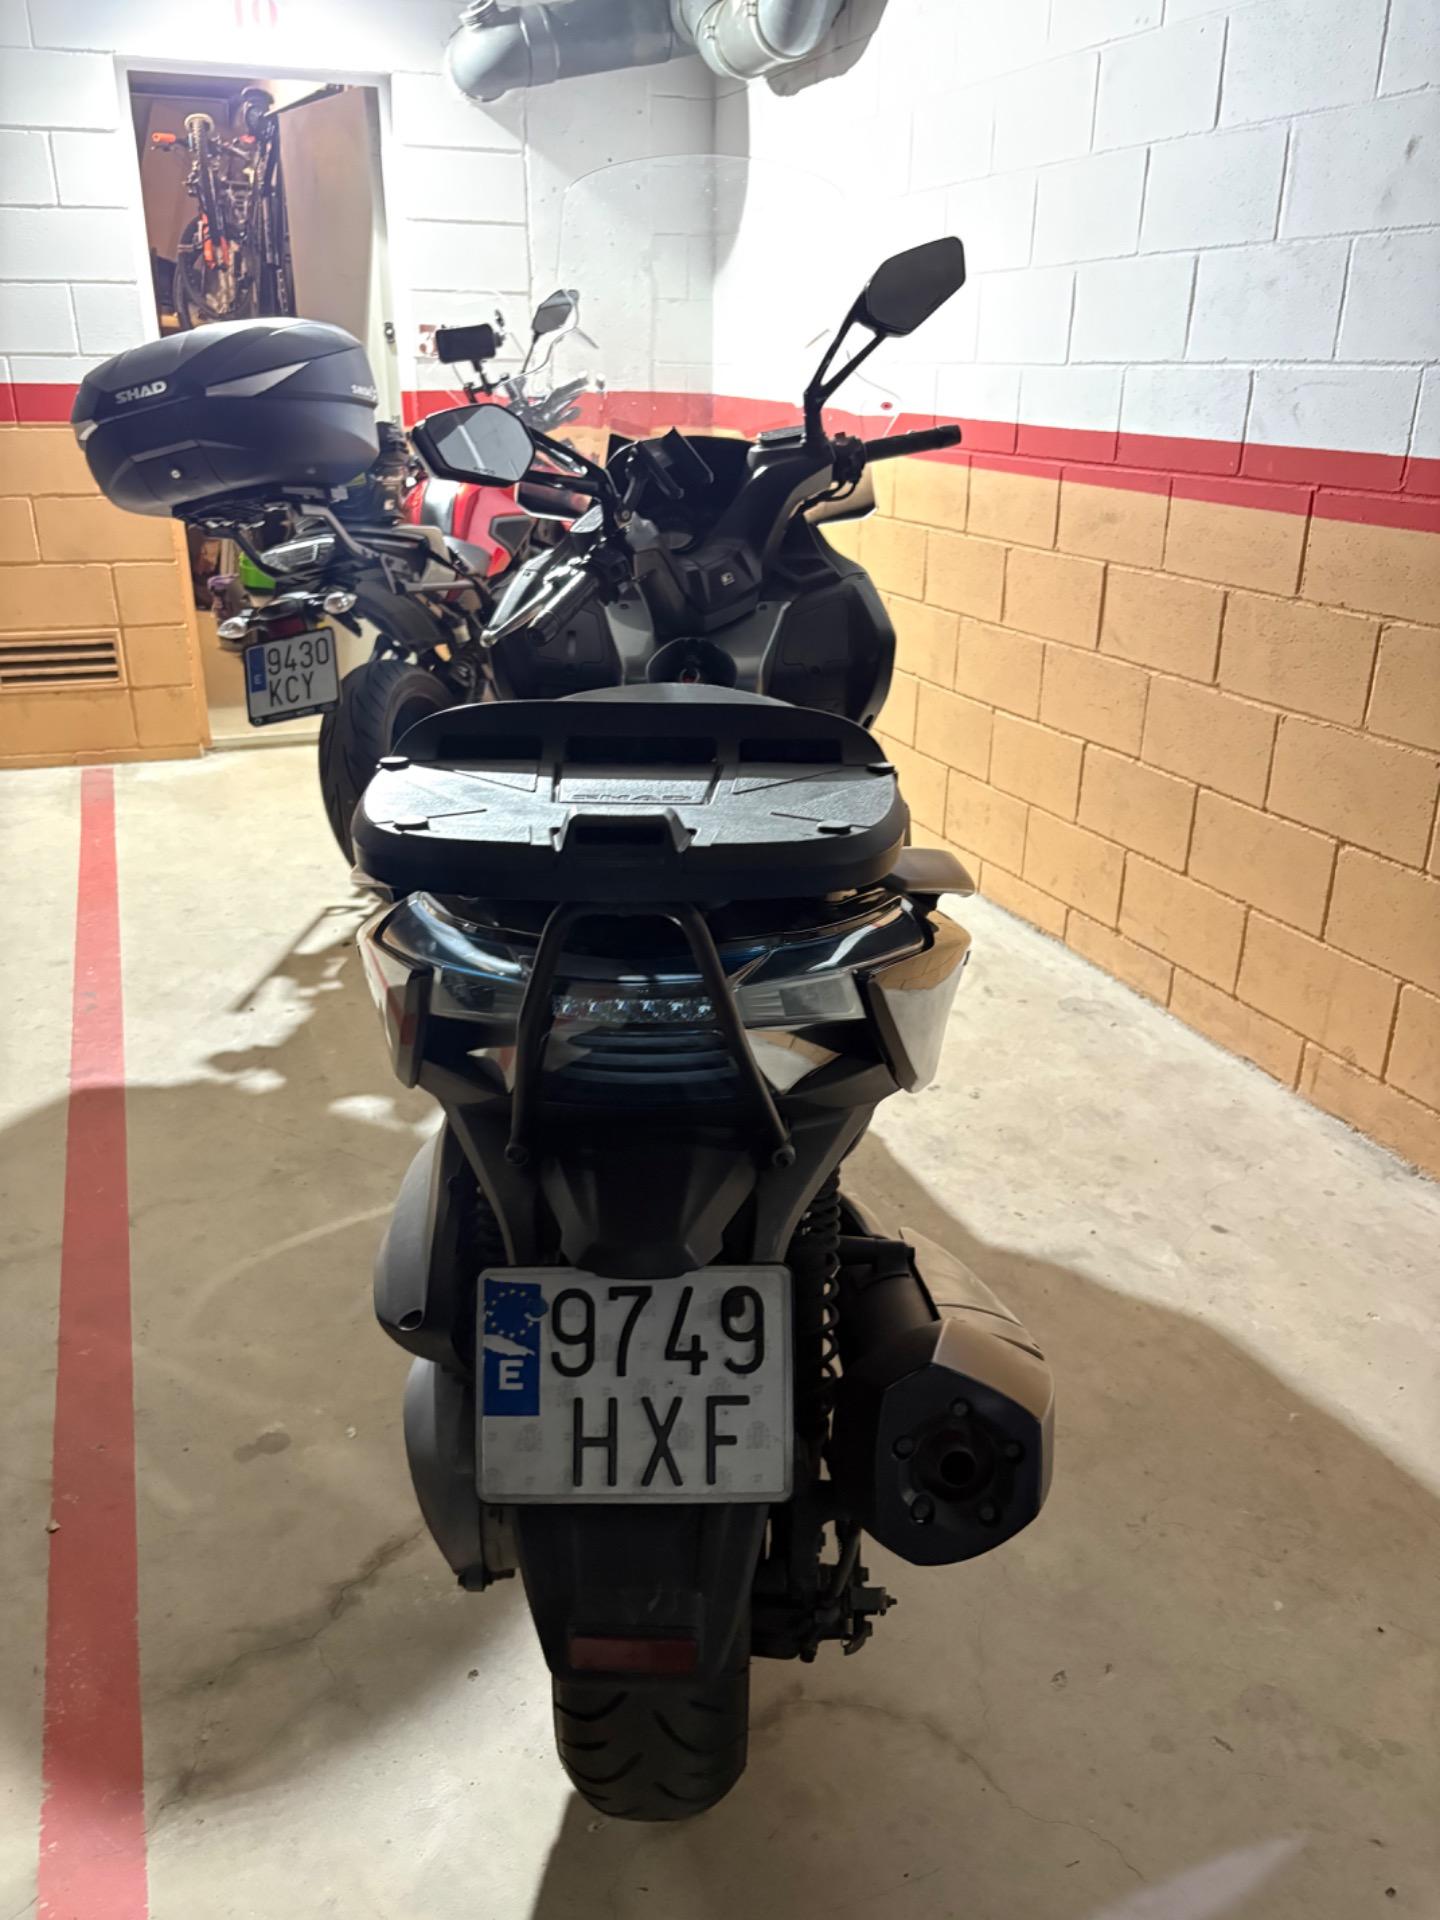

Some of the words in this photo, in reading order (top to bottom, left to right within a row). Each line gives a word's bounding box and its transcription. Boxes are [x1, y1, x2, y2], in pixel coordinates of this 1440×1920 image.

[115, 381, 168, 405] SHAD
[267, 637, 330, 676] 9430
[269, 671, 315, 708] KCY
[551, 1285, 765, 1378] 9749
[499, 1359, 525, 1391] E
[572, 1395, 750, 1488] HXF
